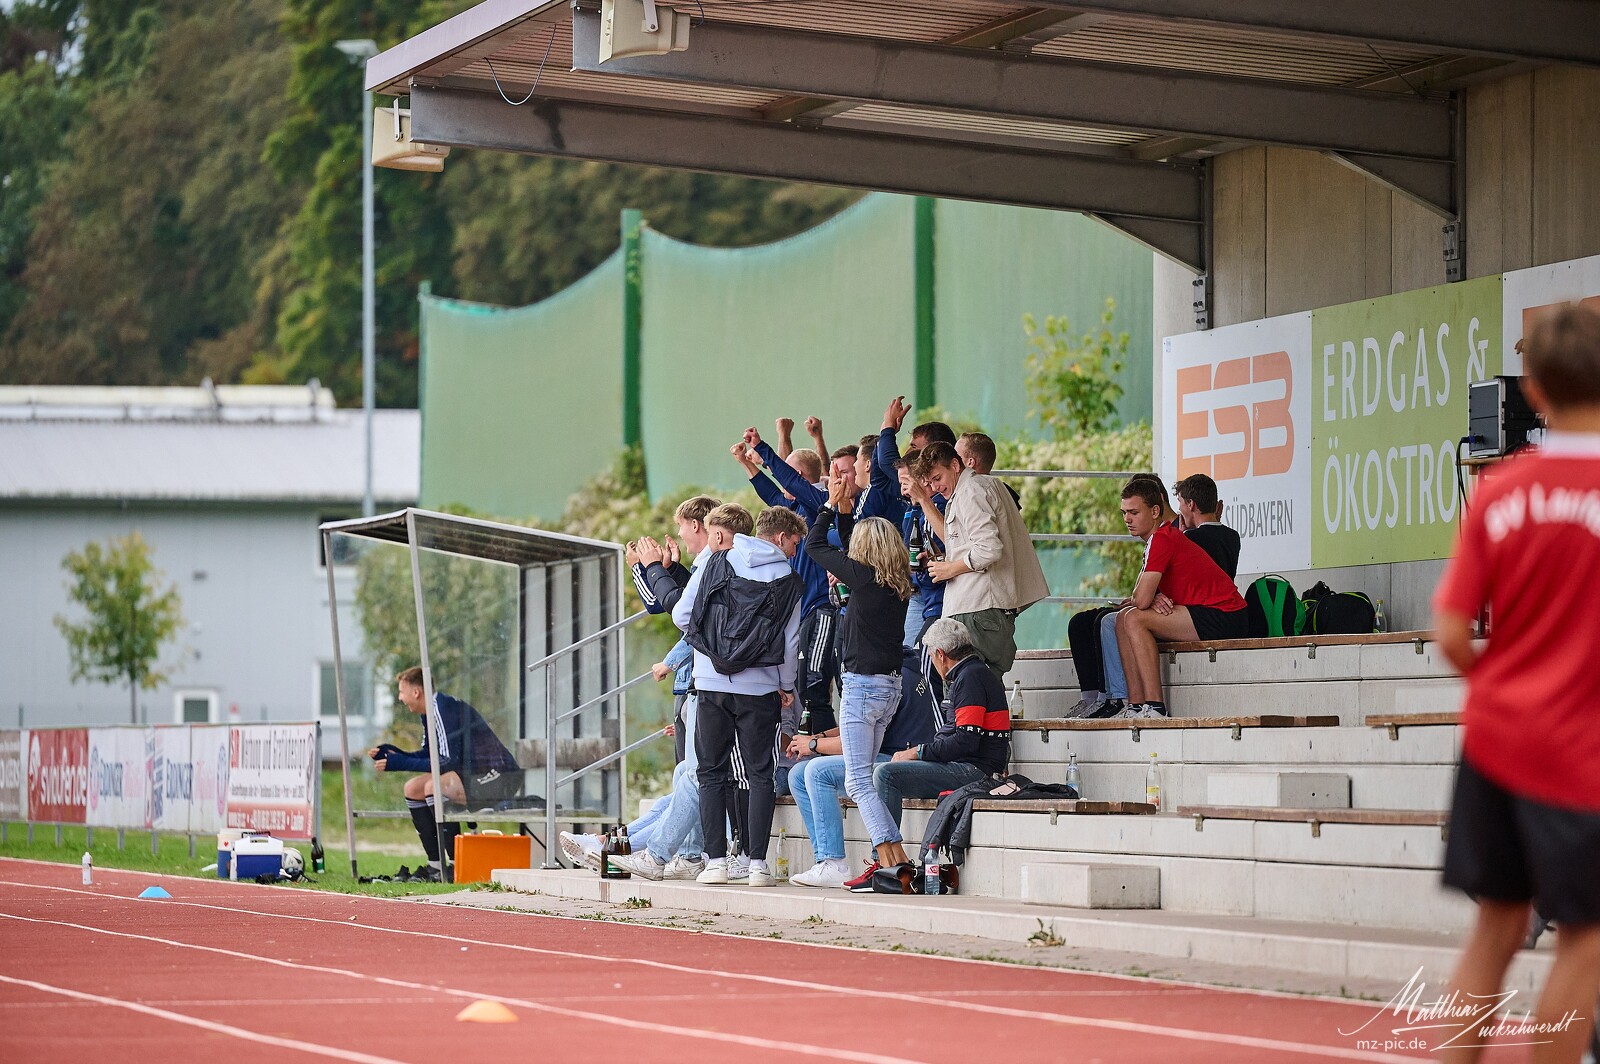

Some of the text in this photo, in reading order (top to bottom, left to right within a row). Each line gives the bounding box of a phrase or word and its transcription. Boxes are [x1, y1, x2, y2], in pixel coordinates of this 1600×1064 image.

[1177, 351, 1294, 482] ESB
[1323, 322, 1450, 422] ERDGAS
[1466, 316, 1489, 385] &
[1225, 496, 1293, 539] SÜDBAYERN
